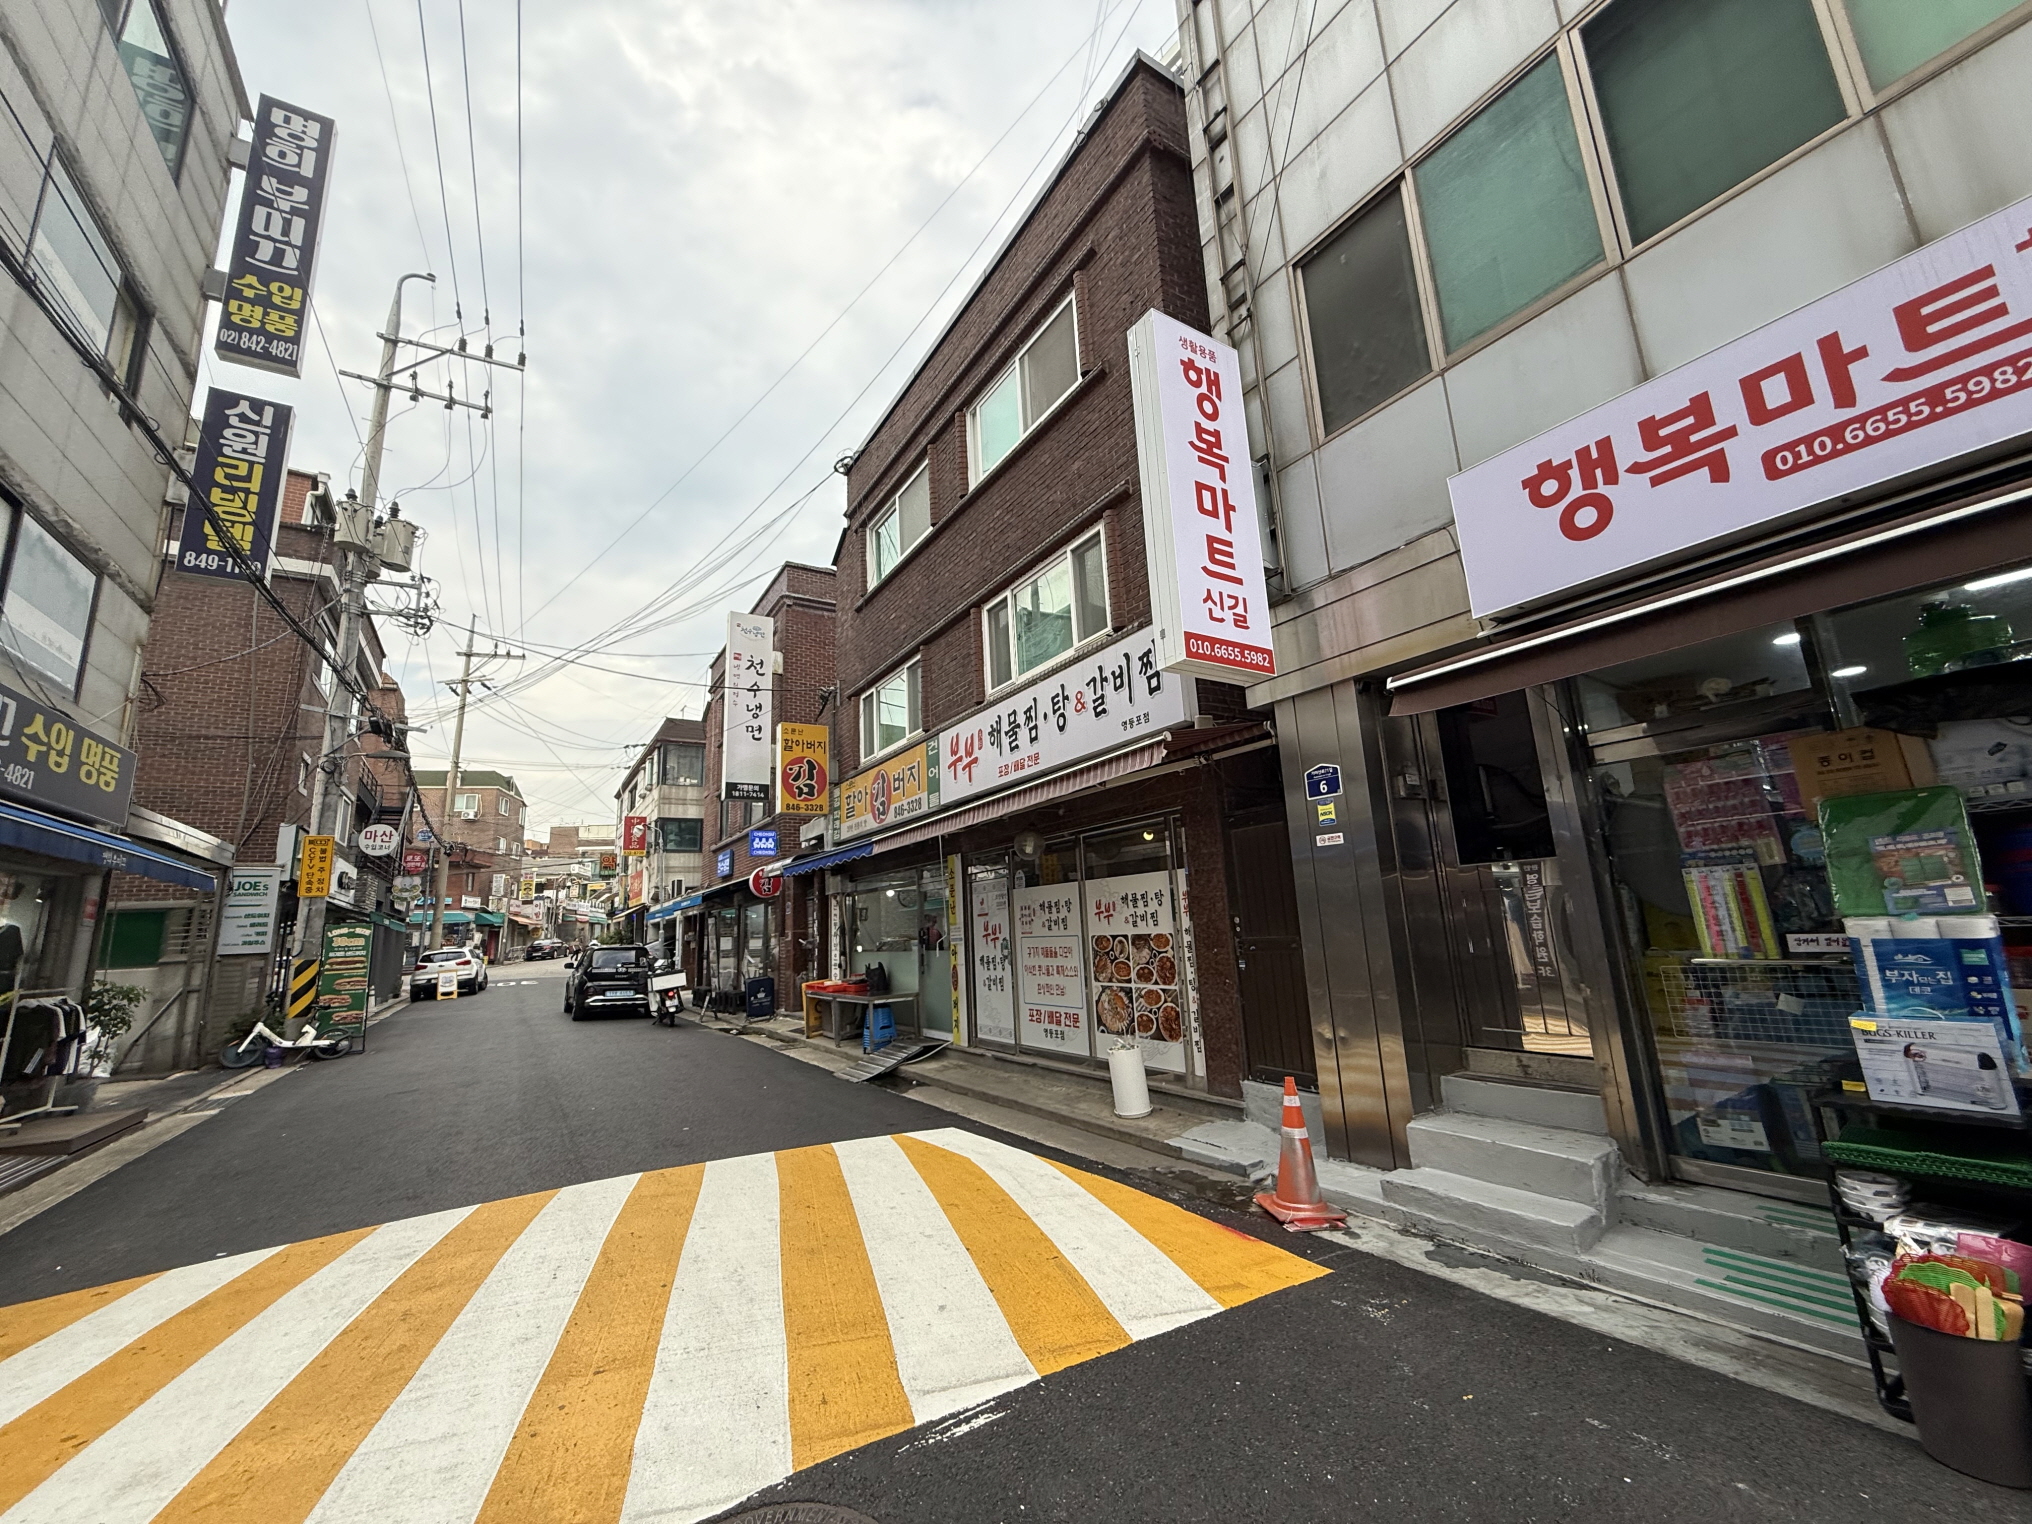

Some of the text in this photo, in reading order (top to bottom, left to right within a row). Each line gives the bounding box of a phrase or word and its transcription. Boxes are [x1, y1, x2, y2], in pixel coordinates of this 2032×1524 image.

[232, 274, 302, 309] 수입
[228, 299, 298, 336] 명품
[240, 332, 298, 360] 842-4821
[1179, 335, 1217, 363] 생활용품
[1521, 263, 2032, 541] 행복마트
[1774, 356, 2032, 472] 010.6655.5982
[1180, 357, 1243, 586] 행복마트
[1203, 588, 1250, 630] 신길
[1190, 638, 1270, 667] 010.6655.5982
[745, 655, 766, 741] 천수냉면
[1121, 712, 1150, 732] 영등포점
[21, 713, 74, 773] 수입
[80, 737, 121, 792] 명품
[783, 738, 826, 754] 할아버지
[947, 732, 979, 784] 부부
[1027, 752, 1040, 768] 전문
[787, 758, 818, 799] 김
[1320, 781, 1328, 793] 6
[785, 803, 824, 811] 846-3328
[872, 770, 887, 822] 김
[894, 797, 921, 819] 846-3328
[364, 830, 393, 843] 마산
[629, 818, 640, 849] 中食品
[308, 847, 316, 869] CCTV
[602, 856, 616, 870] 약
[1094, 899, 1114, 926] 부부
[1064, 1011, 1080, 1028] 전문
[1043, 1028, 1065, 1040] 영등포점
